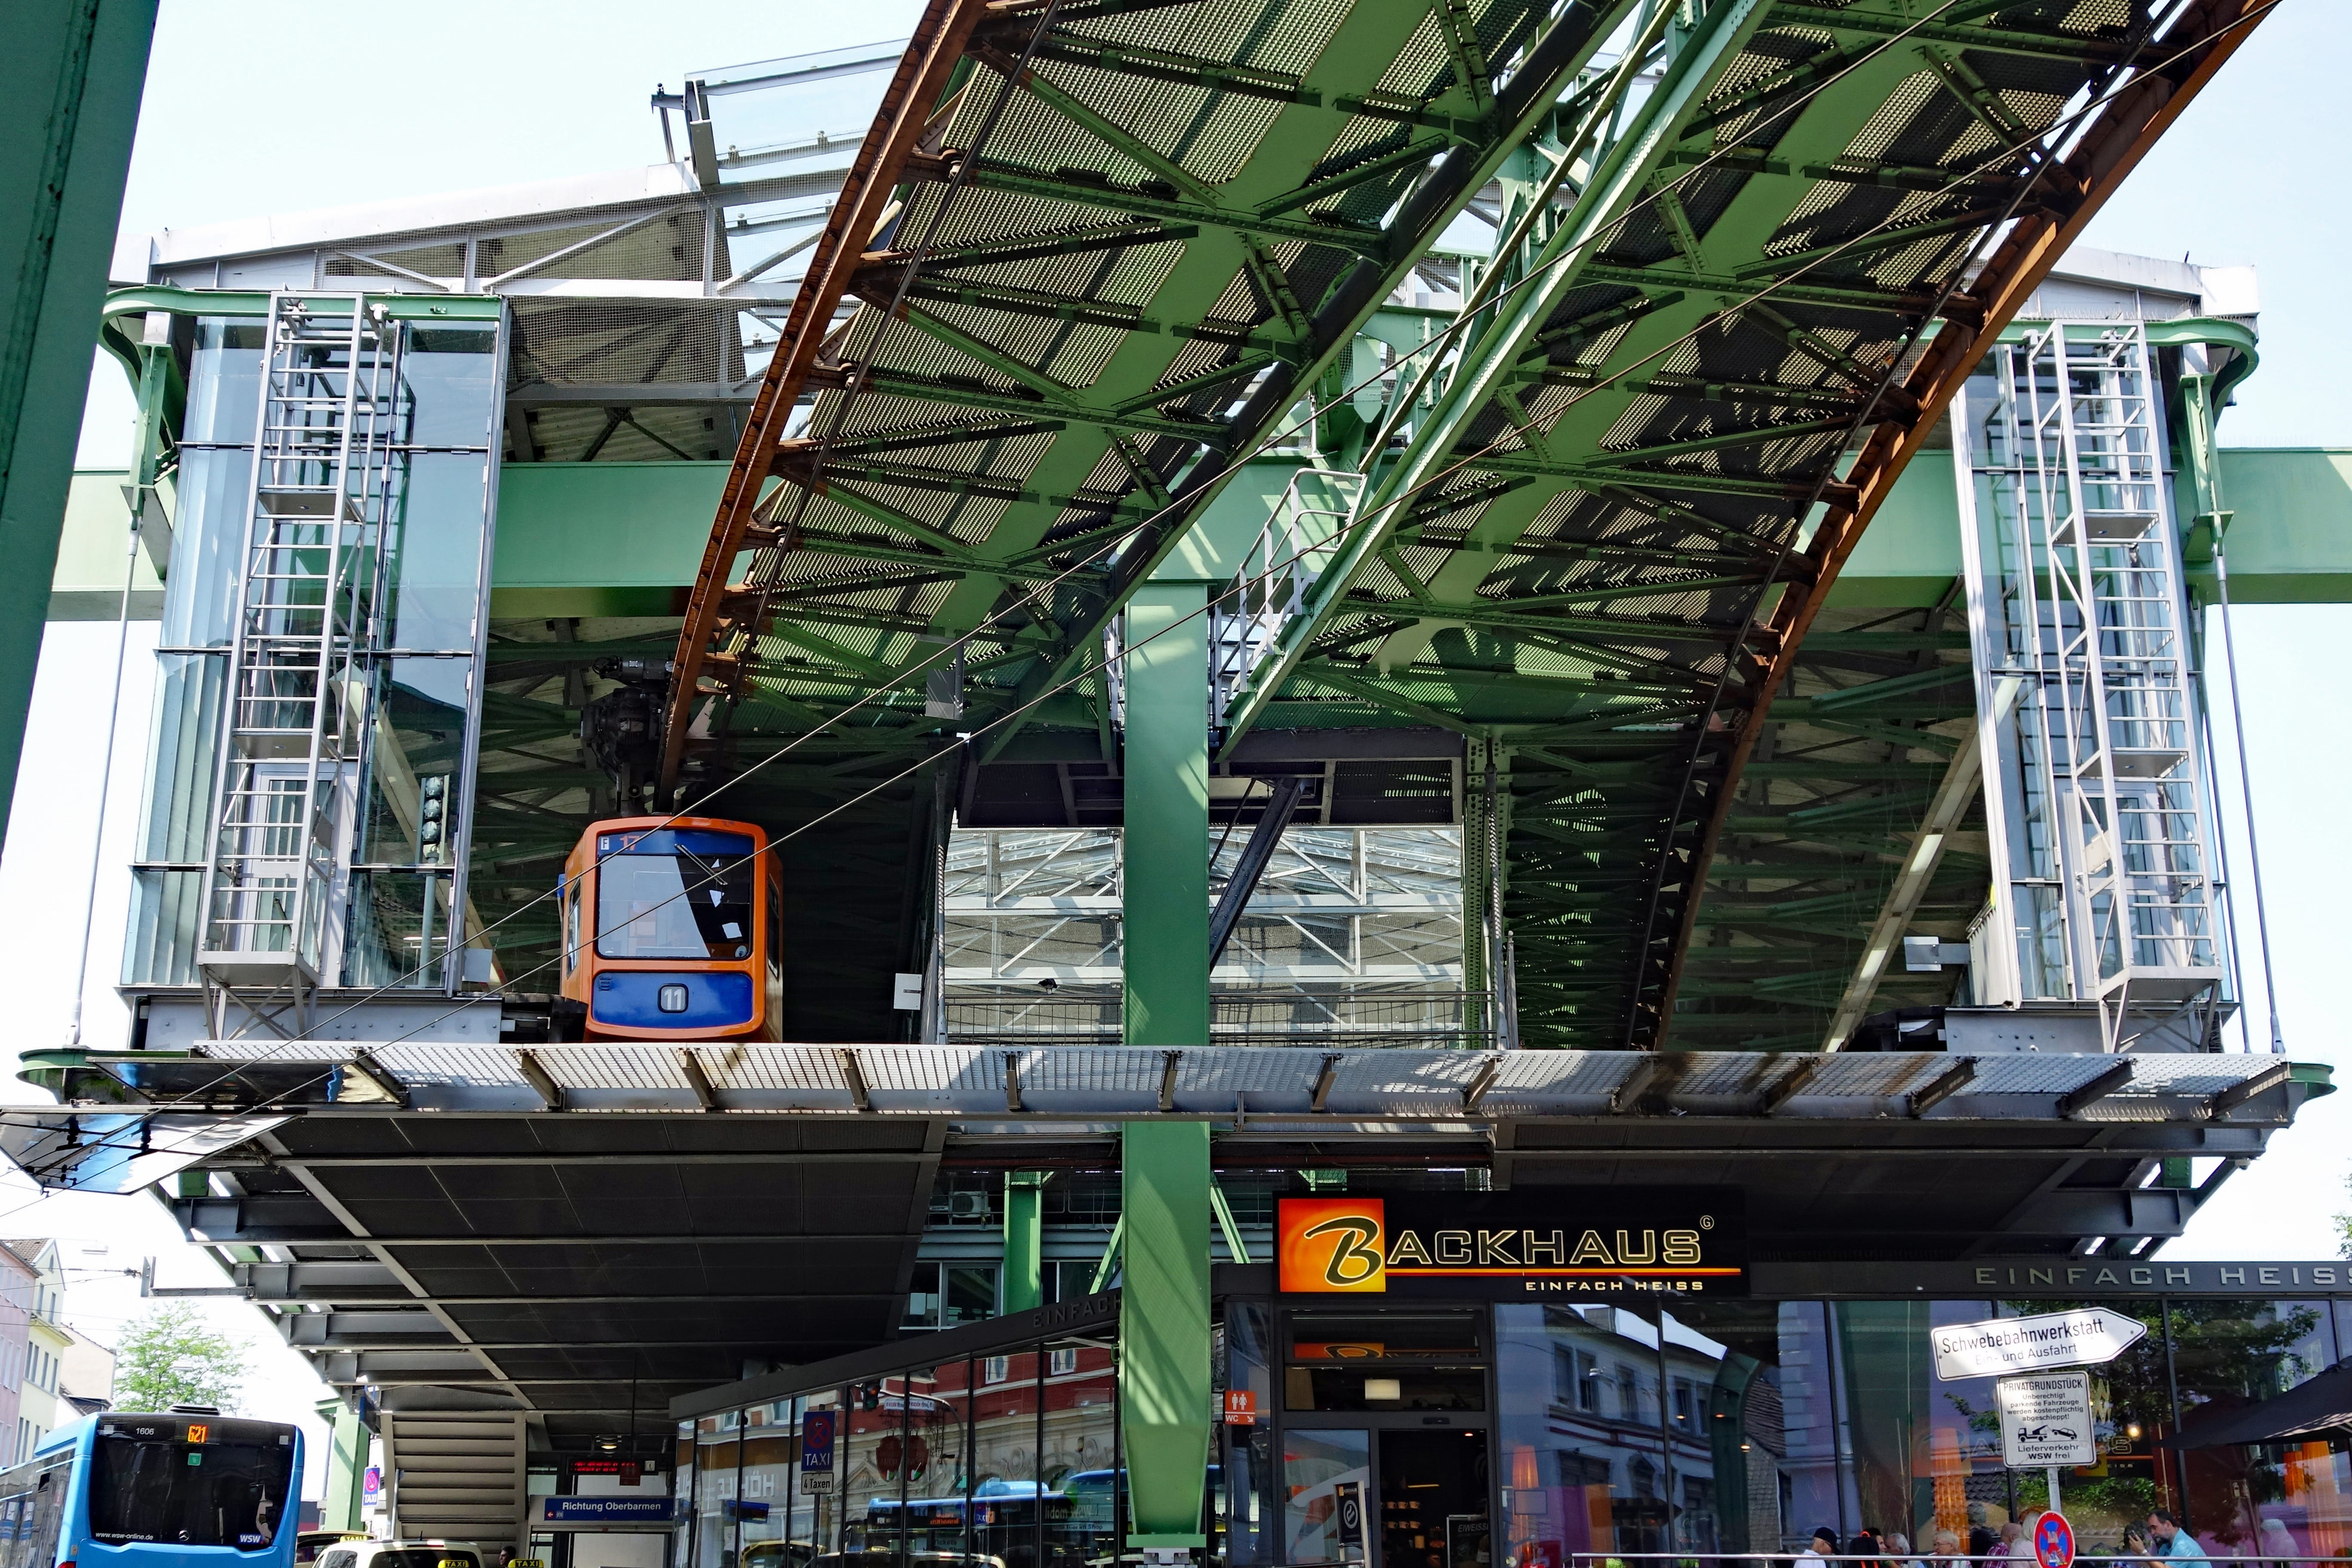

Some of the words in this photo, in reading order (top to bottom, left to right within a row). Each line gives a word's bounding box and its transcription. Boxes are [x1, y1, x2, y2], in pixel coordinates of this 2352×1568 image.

[603, 838, 608, 848] F
[620, 836, 640, 851] 17
[663, 989, 682, 1011] 11
[1304, 1216, 1701, 1287] BACKHAUS
[1976, 1267, 2190, 1285] EINFACH
[2220, 1267, 2352, 1285] HEIS
[1526, 1281, 1622, 1291] EINFACH
[1634, 1281, 1703, 1291] HEISS
[1942, 1318, 2104, 1354] Schwebebahnwerkstatt
[2003, 1350, 2024, 1362] und
[2028, 1344, 2077, 1359] Ausfahrt
[2004, 1377, 2083, 1391] PRIVATGRUNDSTÜCK
[188, 1424, 207, 1442] 621
[805, 1453, 830, 1467] TAXI
[804, 1479, 808, 1489] 4
[810, 1479, 830, 1488] Taxen
[364, 1494, 377, 1504] TAXI
[562, 1502, 603, 1512] Richtung
[605, 1502, 661, 1510] Oberbarmen
[95, 1532, 153, 1540] www.wsw-online.de
